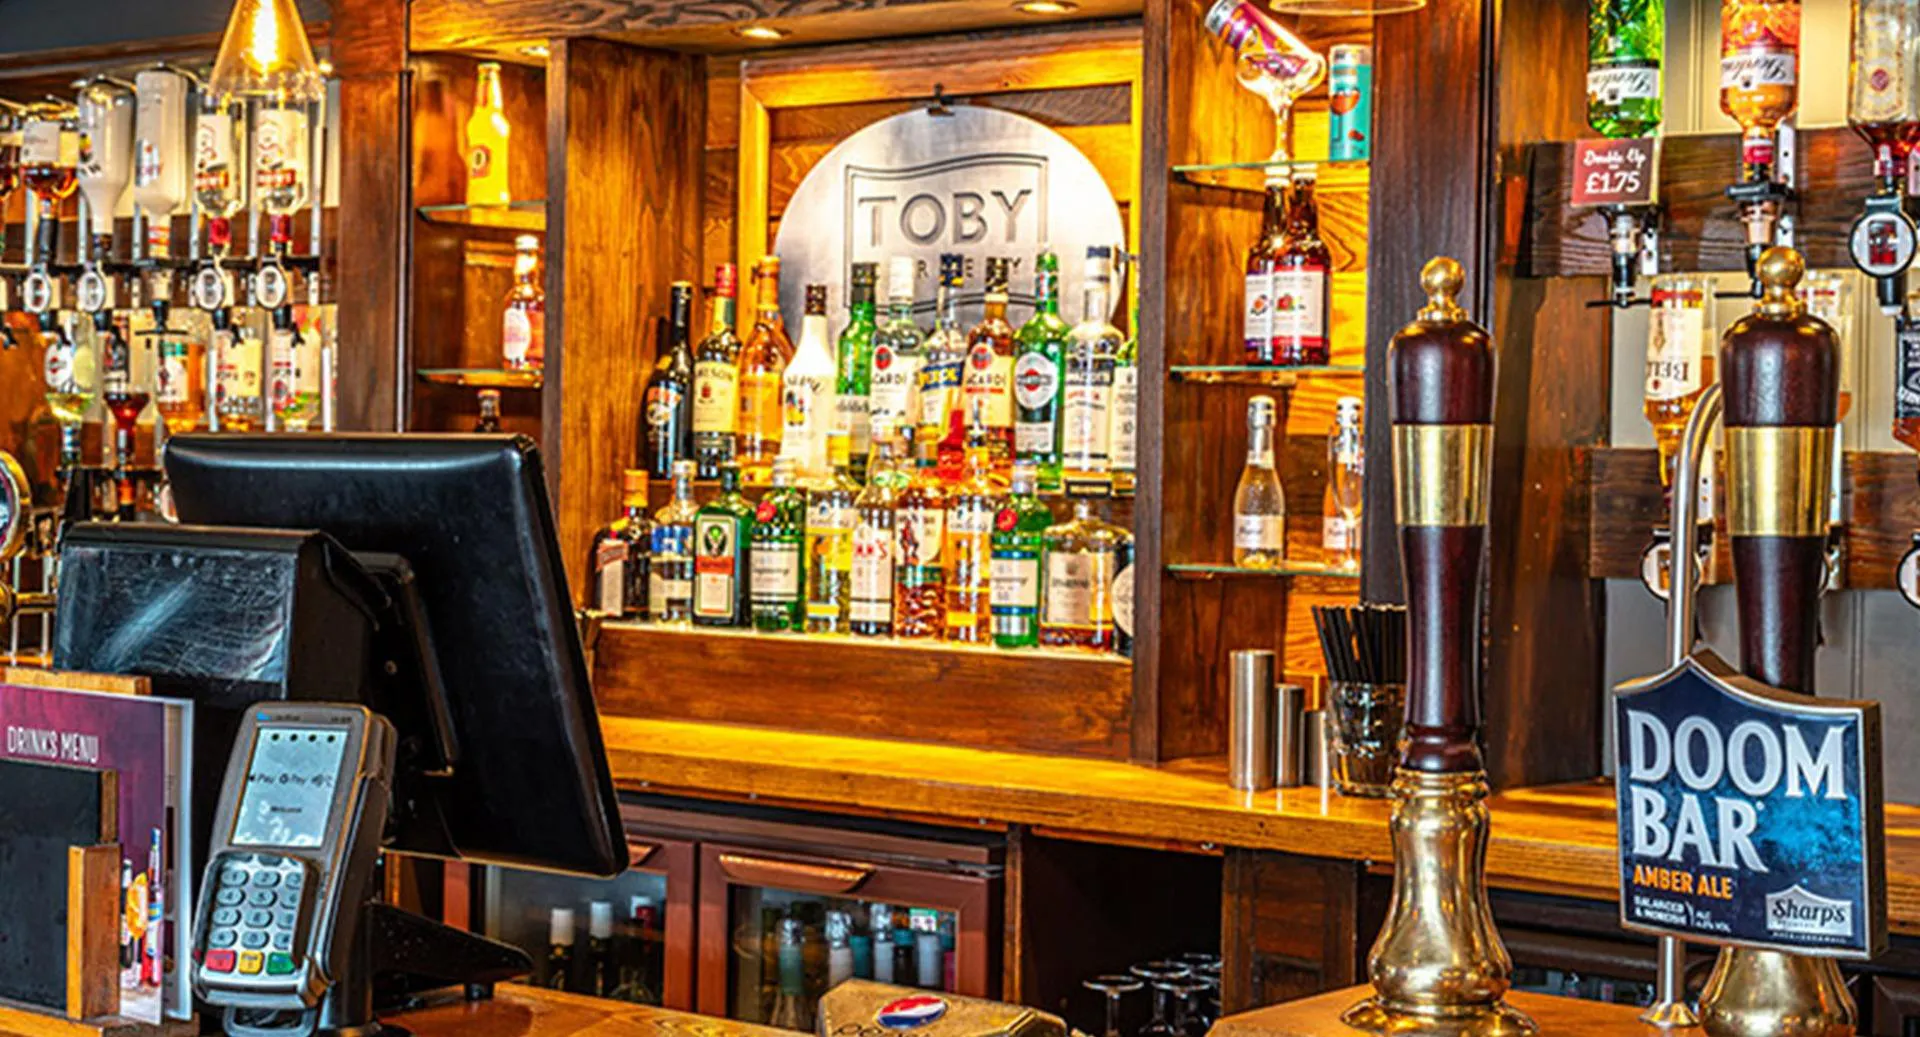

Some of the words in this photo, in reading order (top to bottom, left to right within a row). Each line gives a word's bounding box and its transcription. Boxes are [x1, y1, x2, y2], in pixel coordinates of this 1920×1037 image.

[1583, 150, 1625, 166] Double
[1626, 148, 1646, 169] Up
[1584, 170, 1640, 195] £1.75
[858, 189, 1032, 247] TOBY
[7, 726, 58, 758] DRINKS
[61, 732, 99, 764] MENU
[1627, 709, 1848, 800] DOOM
[1630, 784, 1770, 873] BAR
[1633, 864, 1694, 895] AMBER
[1697, 875, 1733, 900] ALE
[1772, 898, 1846, 927] Sharp's
